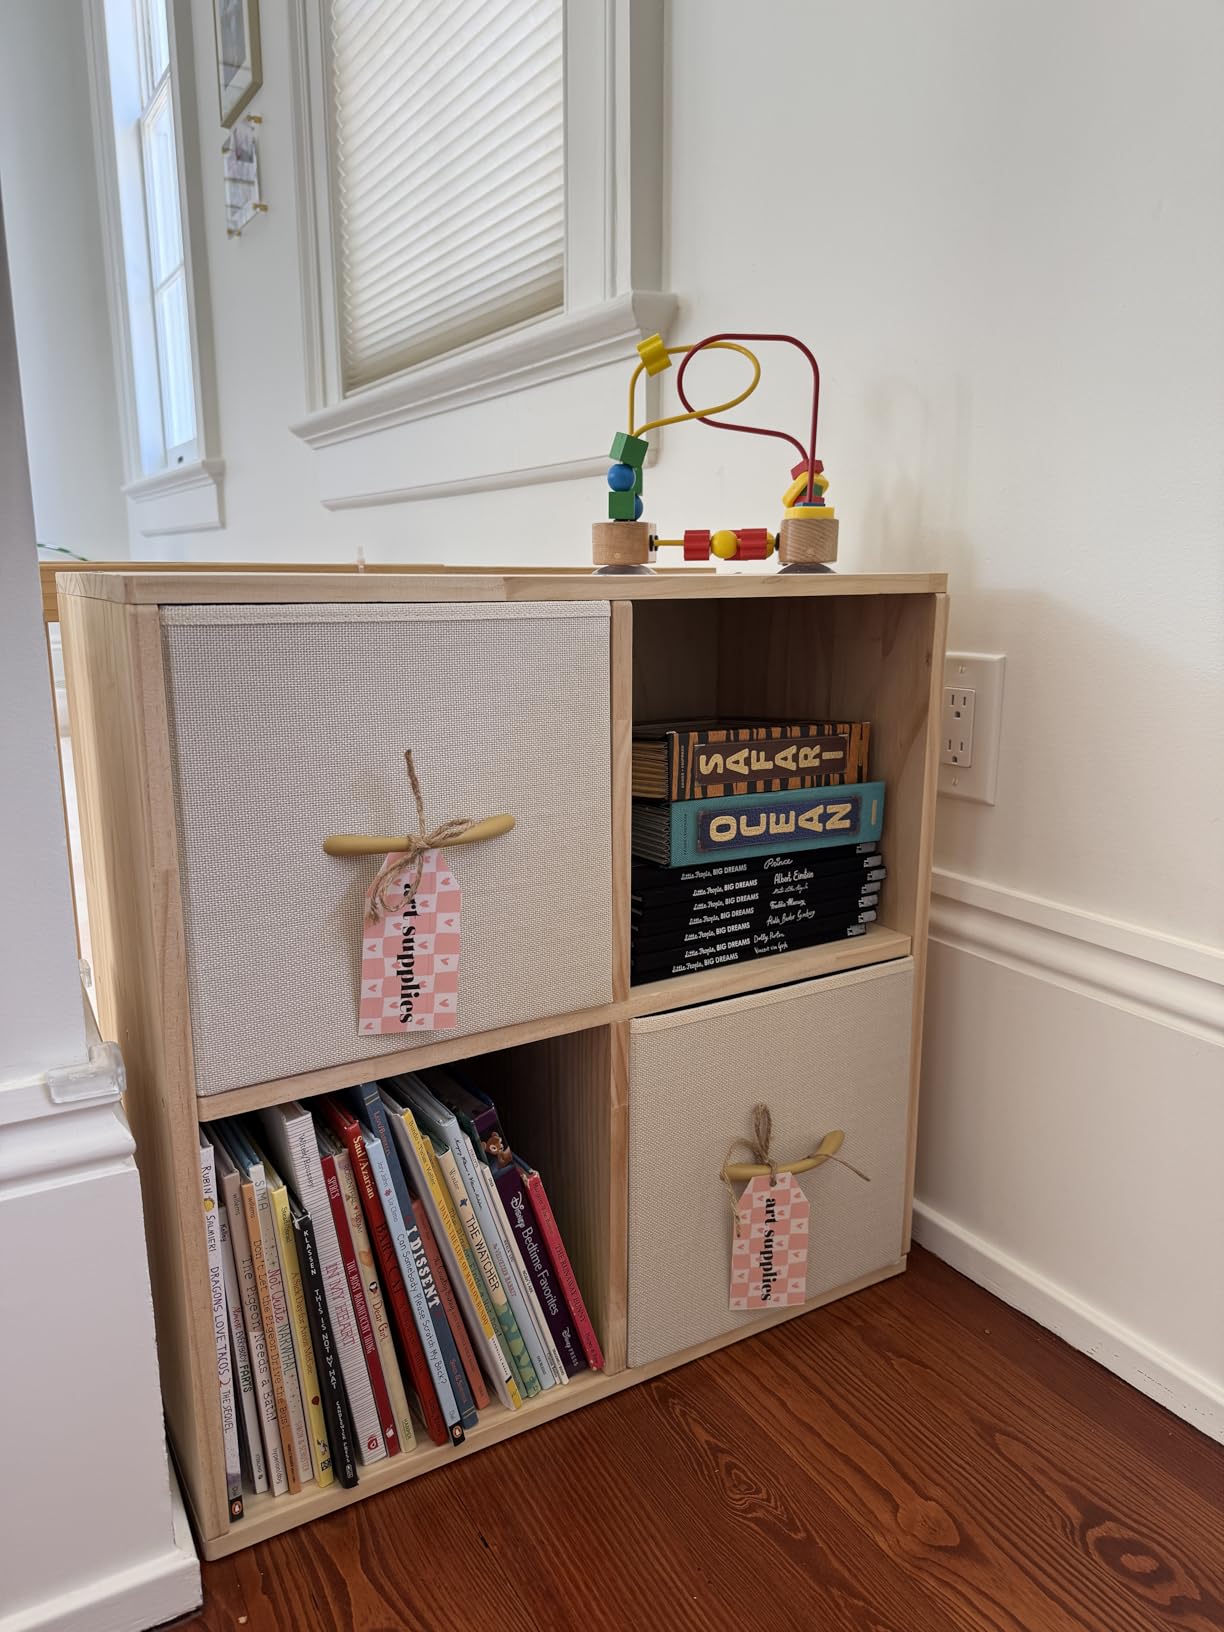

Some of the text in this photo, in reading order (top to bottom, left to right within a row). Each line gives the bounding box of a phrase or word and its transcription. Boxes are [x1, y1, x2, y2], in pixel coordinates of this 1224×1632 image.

[699, 744, 844, 775] SAFARI
[708, 802, 852, 843] OCEAN
[724, 864, 747, 874] DREAMS
[764, 857, 793, 869] Prince
[774, 872, 792, 885] Albert
[735, 879, 758, 888] DREAMS
[736, 893, 759, 902] DREAMS
[727, 922, 750, 932] DREAMS
[732, 907, 754, 917] DREAMS
[716, 943, 726, 951] BIG
[728, 938, 750, 948] DREAMS
[754, 933, 768, 943] Dolly
[396, 926, 421, 1024] supplies
[704, 958, 714, 966] BIG
[715, 953, 738, 963] DREAMS
[201, 1166, 212, 1194] RUBIN
[326, 1175, 340, 1199] SPIRES
[449, 1168, 459, 1190] Winter
[254, 1180, 268, 1211] SIMA
[206, 1215, 216, 1252] SALMIERI
[376, 1222, 394, 1254] BARN
[449, 1230, 458, 1244] THE
[454, 1245, 464, 1263] LIFE
[760, 1198, 778, 1301] art supplies
[304, 1230, 316, 1275] KLASSEN
[410, 1225, 418, 1236] I
[414, 1238, 439, 1307] DISSENT
[466, 1214, 500, 1291] THE WATCHER
[508, 1192, 559, 1315] Disney Bedtime Favorites
[555, 1244, 586, 1322] THE RUNAWAY BUNNY
[325, 1263, 355, 1346] IN MY HEART
[346, 1260, 375, 1354] THE MOST MAGNIFICENT THING
[372, 1301, 383, 1322] Dear
[397, 1233, 407, 1251] Can
[402, 1252, 417, 1292] Somebody
[413, 1293, 425, 1319] Please
[422, 1320, 435, 1348] Scratch
[430, 1349, 438, 1361] My
[434, 1361, 447, 1384] Back?
[253, 1240, 289, 1429] Don't Let the Pigeon Drive the Bus!
[268, 1269, 295, 1375] Not Quite NARWHAL
[314, 1289, 323, 1315] THIS
[320, 1317, 327, 1331] IS
[326, 1355, 333, 1367] MY
[210, 1266, 233, 1432] DRAGONS LOVE TACOS 2 THE SEQUEL
[235, 1330, 247, 1362] EVERYBODY
[242, 1257, 276, 1422] The Pigeon Needs a Bath!
[240, 1364, 252, 1392] FARTS
